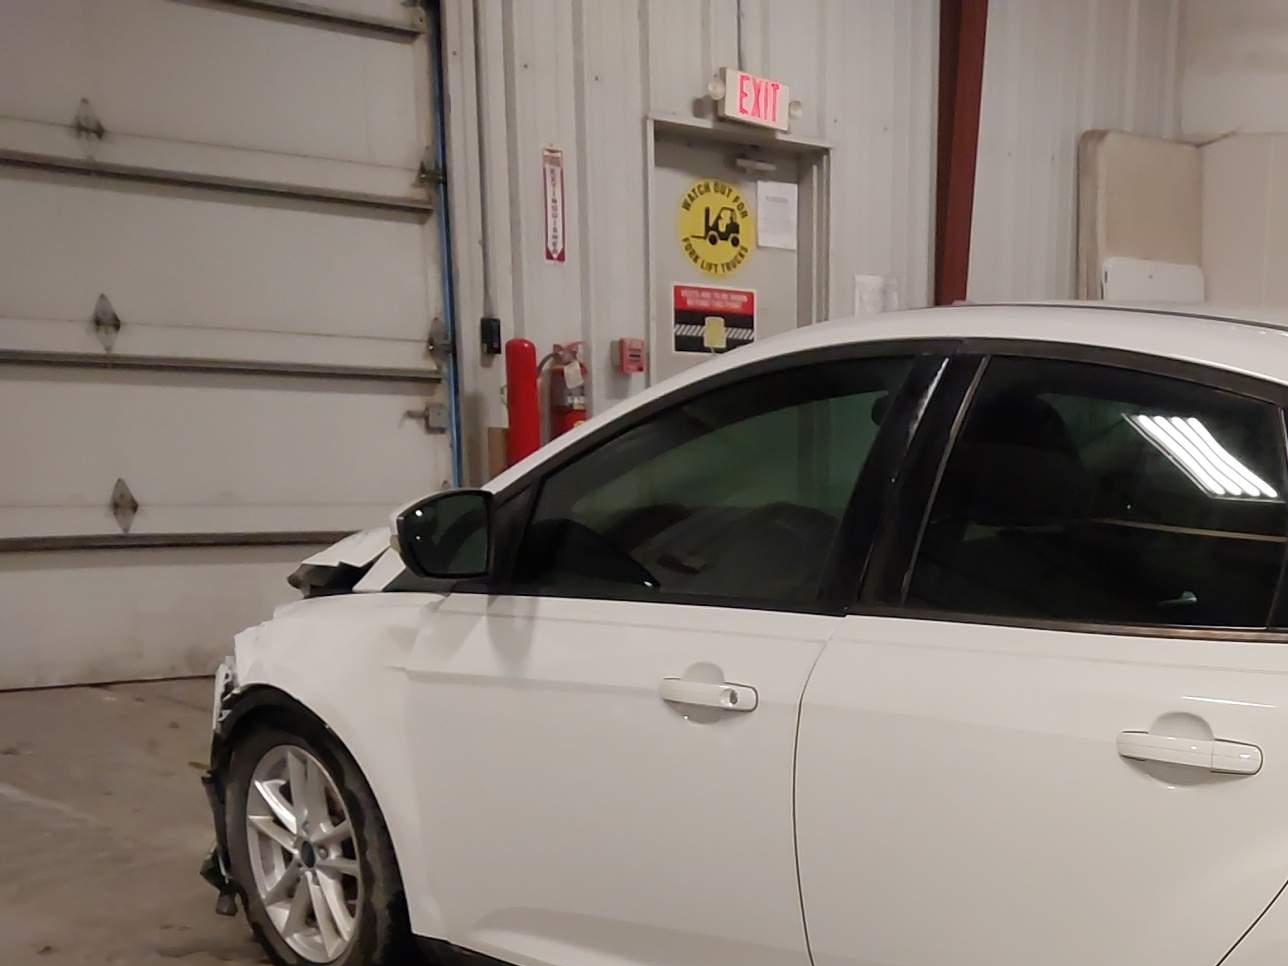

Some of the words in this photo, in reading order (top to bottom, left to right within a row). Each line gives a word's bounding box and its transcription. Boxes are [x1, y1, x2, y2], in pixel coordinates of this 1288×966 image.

[739, 75, 781, 122] EXIT
[681, 181, 711, 211] WATCH
[713, 182, 733, 198] OUT
[732, 195, 749, 219] FOR
[681, 237, 700, 263] FORK
[700, 259, 718, 274] LIFT
[720, 245, 749, 273] TRUCKS
